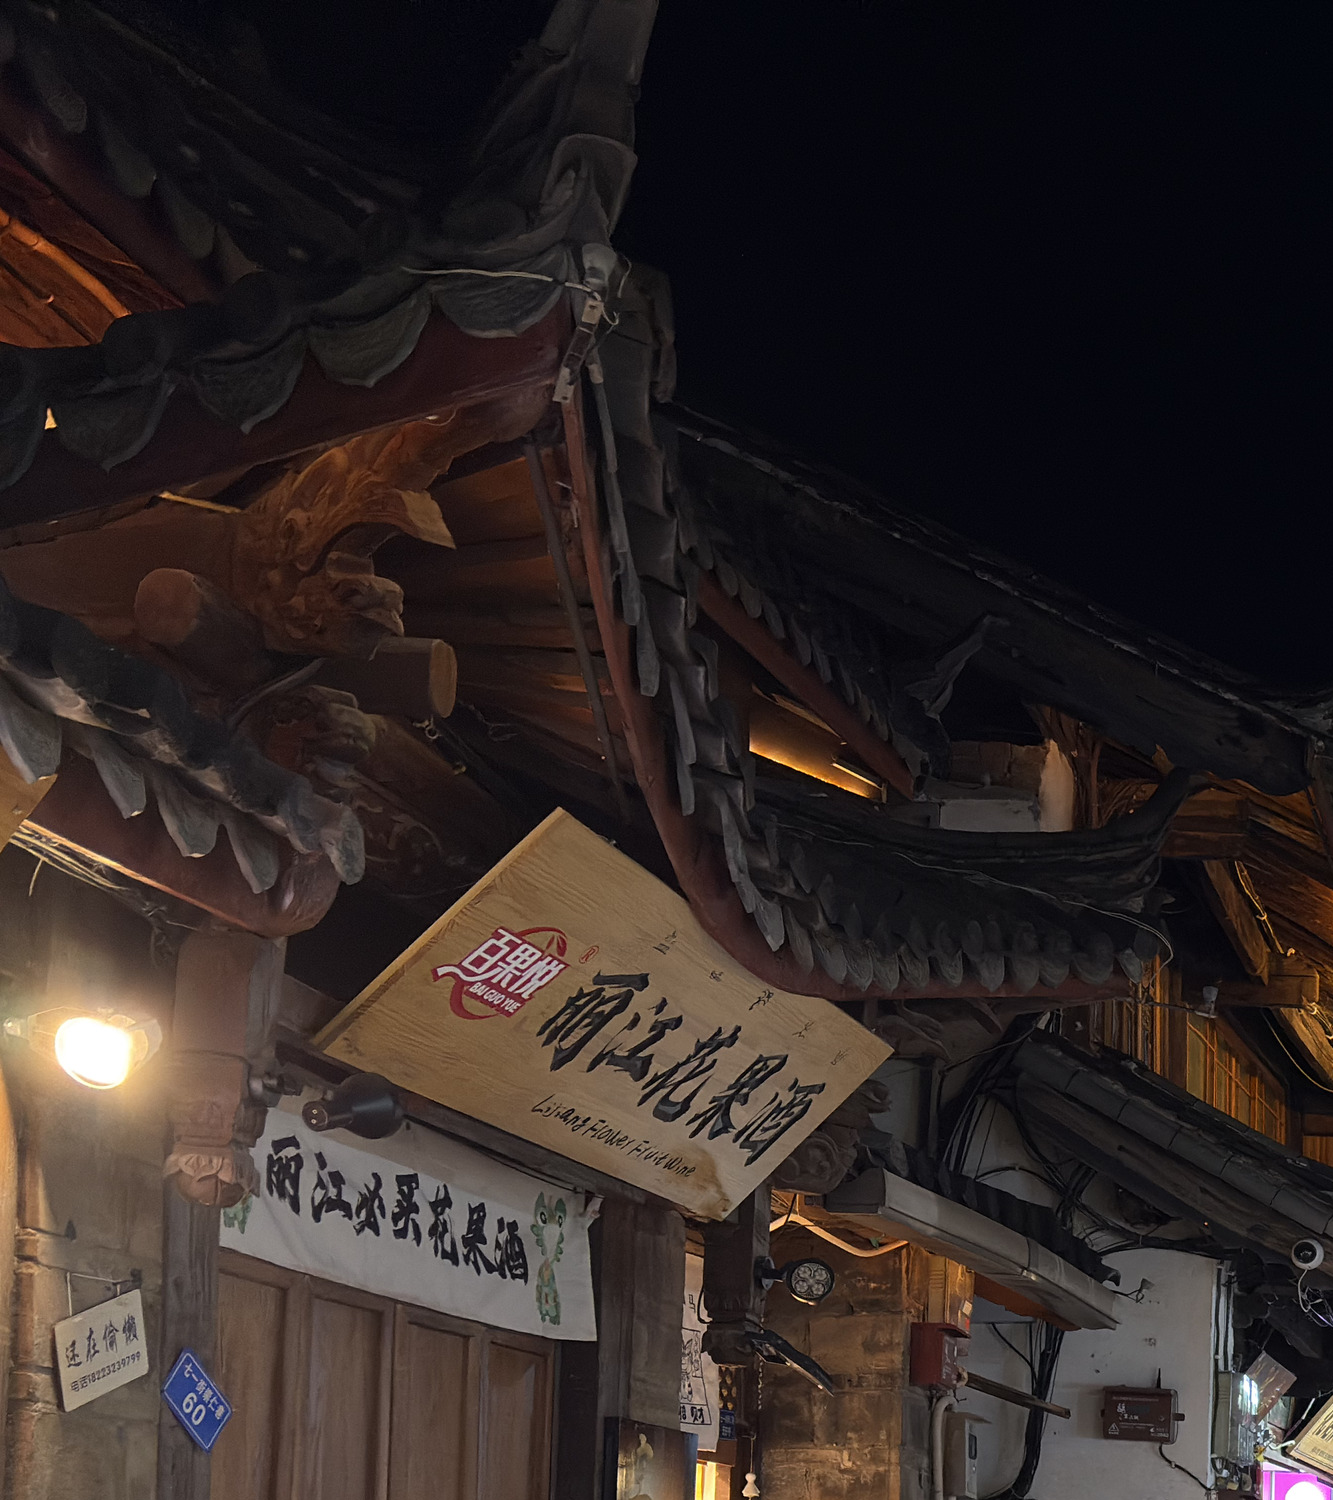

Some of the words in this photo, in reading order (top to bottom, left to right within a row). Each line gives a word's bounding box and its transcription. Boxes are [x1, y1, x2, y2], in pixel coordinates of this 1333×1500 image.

[438, 928, 566, 1000] 百果悦
[469, 982, 485, 996] BAI
[483, 989, 503, 1005] GUO
[501, 998, 522, 1013] YUE
[536, 971, 826, 1167] 丽江花果酒
[531, 1094, 592, 1132] Lijiang
[266, 1135, 529, 1285] 丽江必买花果酒
[182, 1392, 206, 1426] 60
